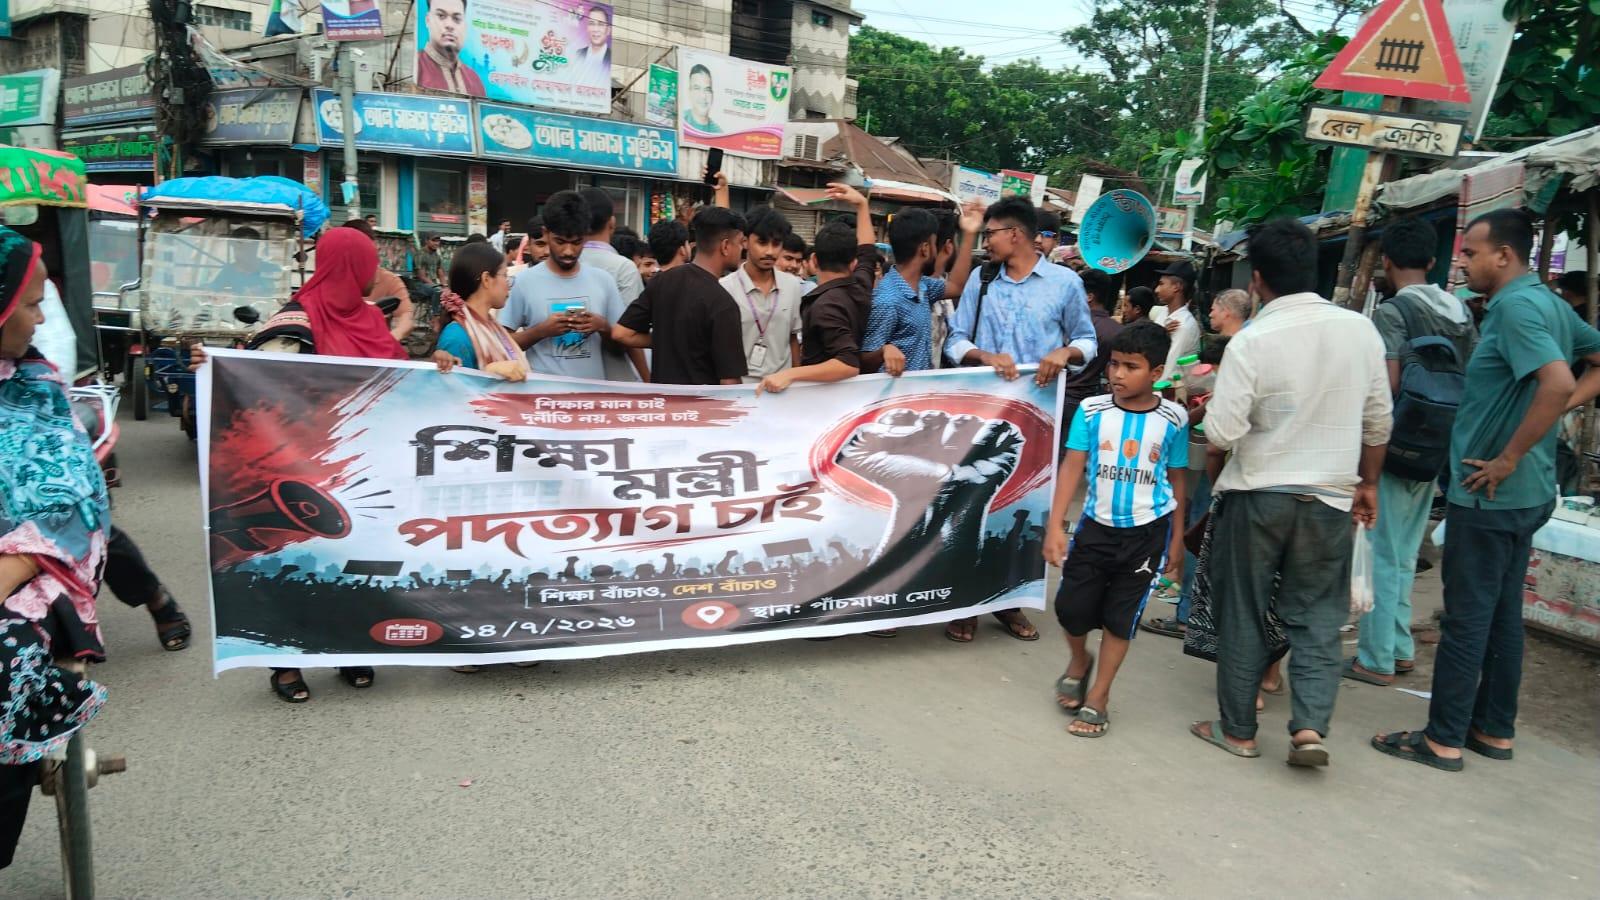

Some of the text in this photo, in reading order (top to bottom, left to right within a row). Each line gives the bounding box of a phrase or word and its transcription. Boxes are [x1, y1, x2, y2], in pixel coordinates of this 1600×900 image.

[362, 106, 393, 128] আল
[534, 124, 576, 150] আল
[1321, 119, 1447, 153] রেল ক্রসিং
[535, 397, 665, 411] শিক্ষার মান চাই
[577, 412, 611, 425] নয়,
[616, 412, 667, 424] জবাব
[667, 410, 700, 423] চাই
[409, 424, 635, 477] শিক্ষা
[597, 449, 770, 500] মন্ত্রী
[1096, 463, 1158, 486] ARGENTINA
[399, 481, 827, 559] পদত্যাগ চাই
[539, 577, 777, 603] শিক্ষা বাঁচাও, দেশ বাঁচাও
[749, 586, 953, 619] স্থান: পাঁচমাথা মোড়
